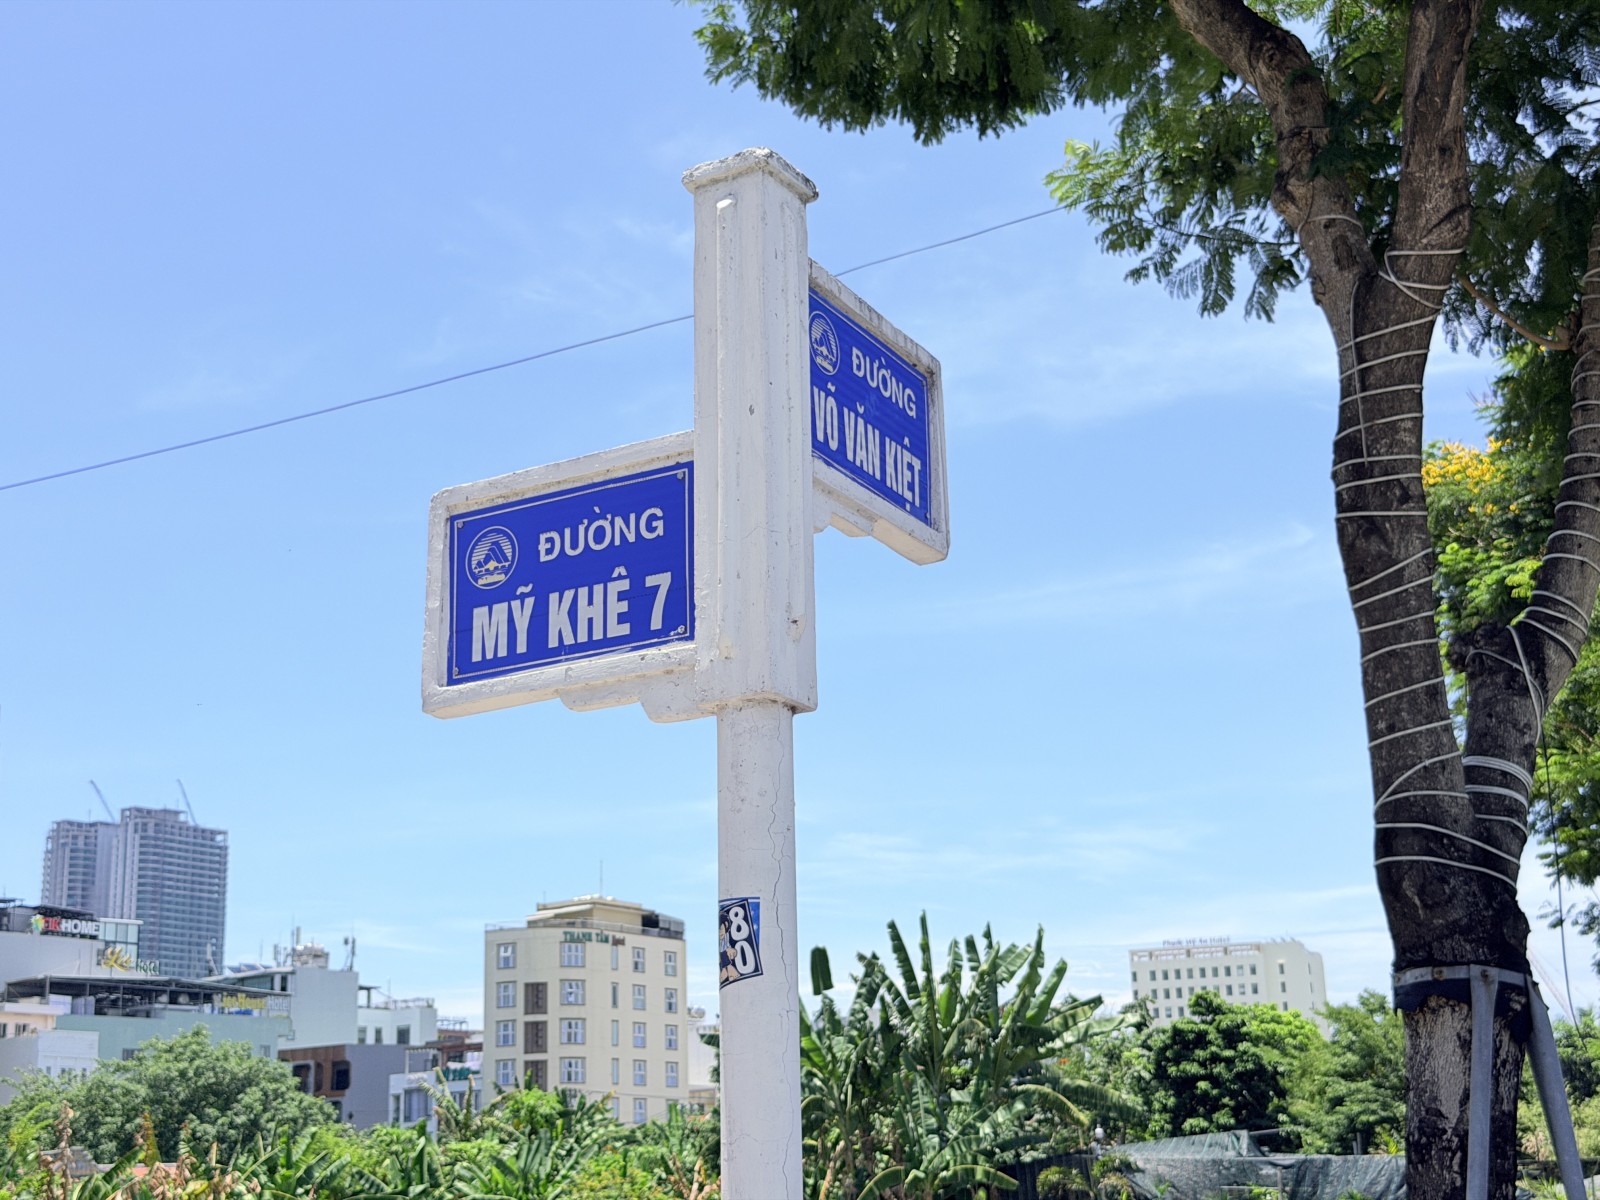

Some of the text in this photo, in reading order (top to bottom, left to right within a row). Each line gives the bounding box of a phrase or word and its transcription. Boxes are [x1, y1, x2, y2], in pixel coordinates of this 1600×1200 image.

[851, 346, 916, 419] ĐƯỜNG
[813, 382, 922, 512] VÕ VĂN KIỆT
[538, 505, 665, 563] ĐƯỜNG
[471, 565, 672, 663] MỸ KHÊ 7
